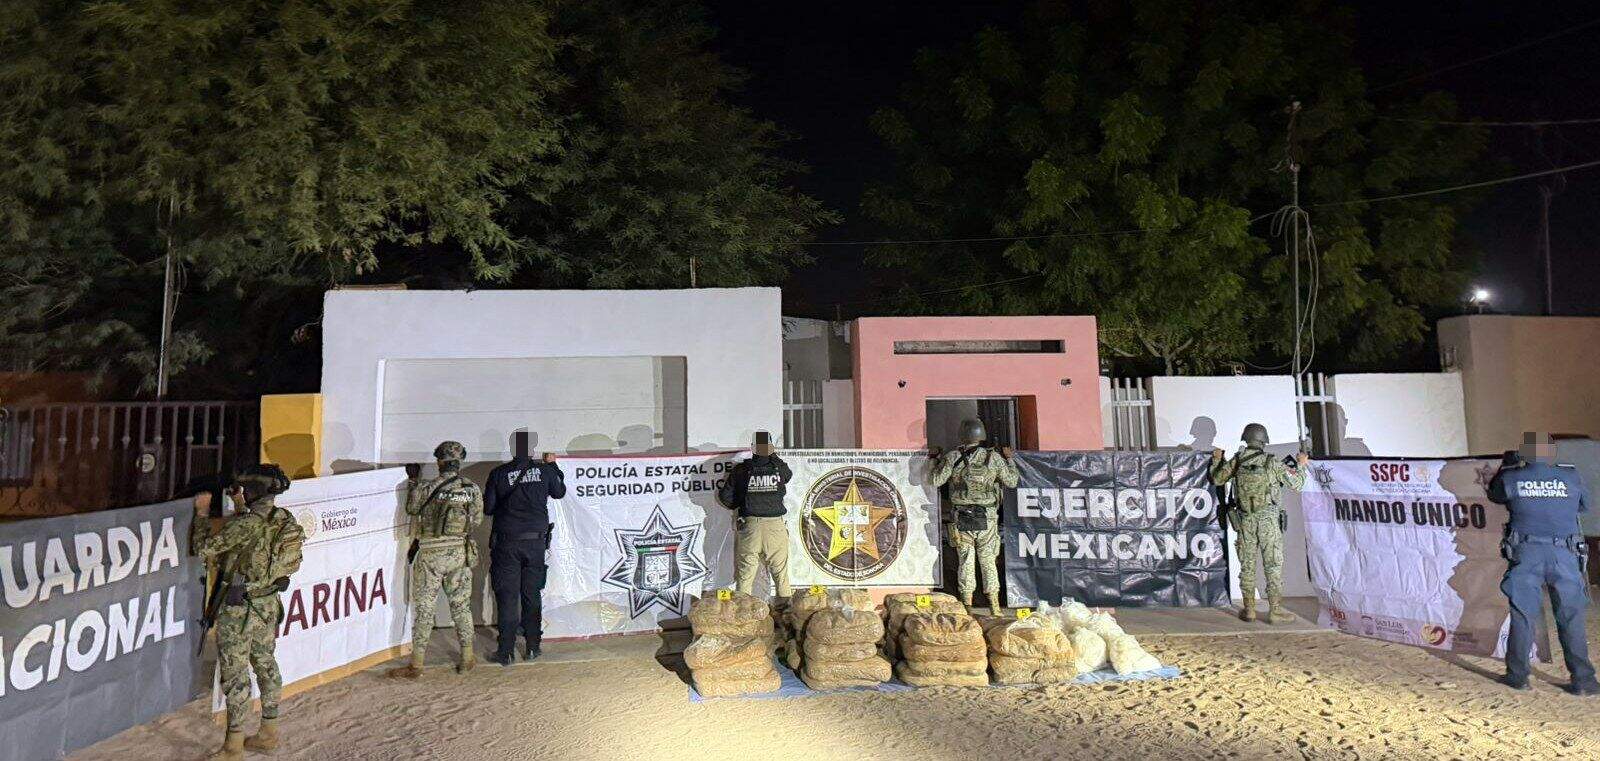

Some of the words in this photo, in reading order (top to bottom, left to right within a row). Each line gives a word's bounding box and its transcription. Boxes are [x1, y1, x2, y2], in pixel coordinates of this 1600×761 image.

[575, 463, 638, 479] POLICÍA
[645, 464, 707, 477] ESTATAL
[714, 461, 733, 473] DE
[1370, 463, 1410, 482] SSPC
[576, 481, 665, 497] SEGURIDAD
[672, 477, 728, 493] PÚBLIC
[1517, 479, 1567, 490] POLICÍA
[1518, 489, 1568, 498] MUNICIPAL
[1017, 480, 1212, 519] EJÉRCITO
[322, 517, 357, 532] México
[1335, 498, 1406, 524] MANDO
[1411, 497, 1486, 529] ÚNICO
[1018, 532, 1215, 560] MEXICANO
[0, 517, 179, 608] UARDIA
[275, 568, 387, 639] ARINA
[0, 586, 185, 697] CIONAL
